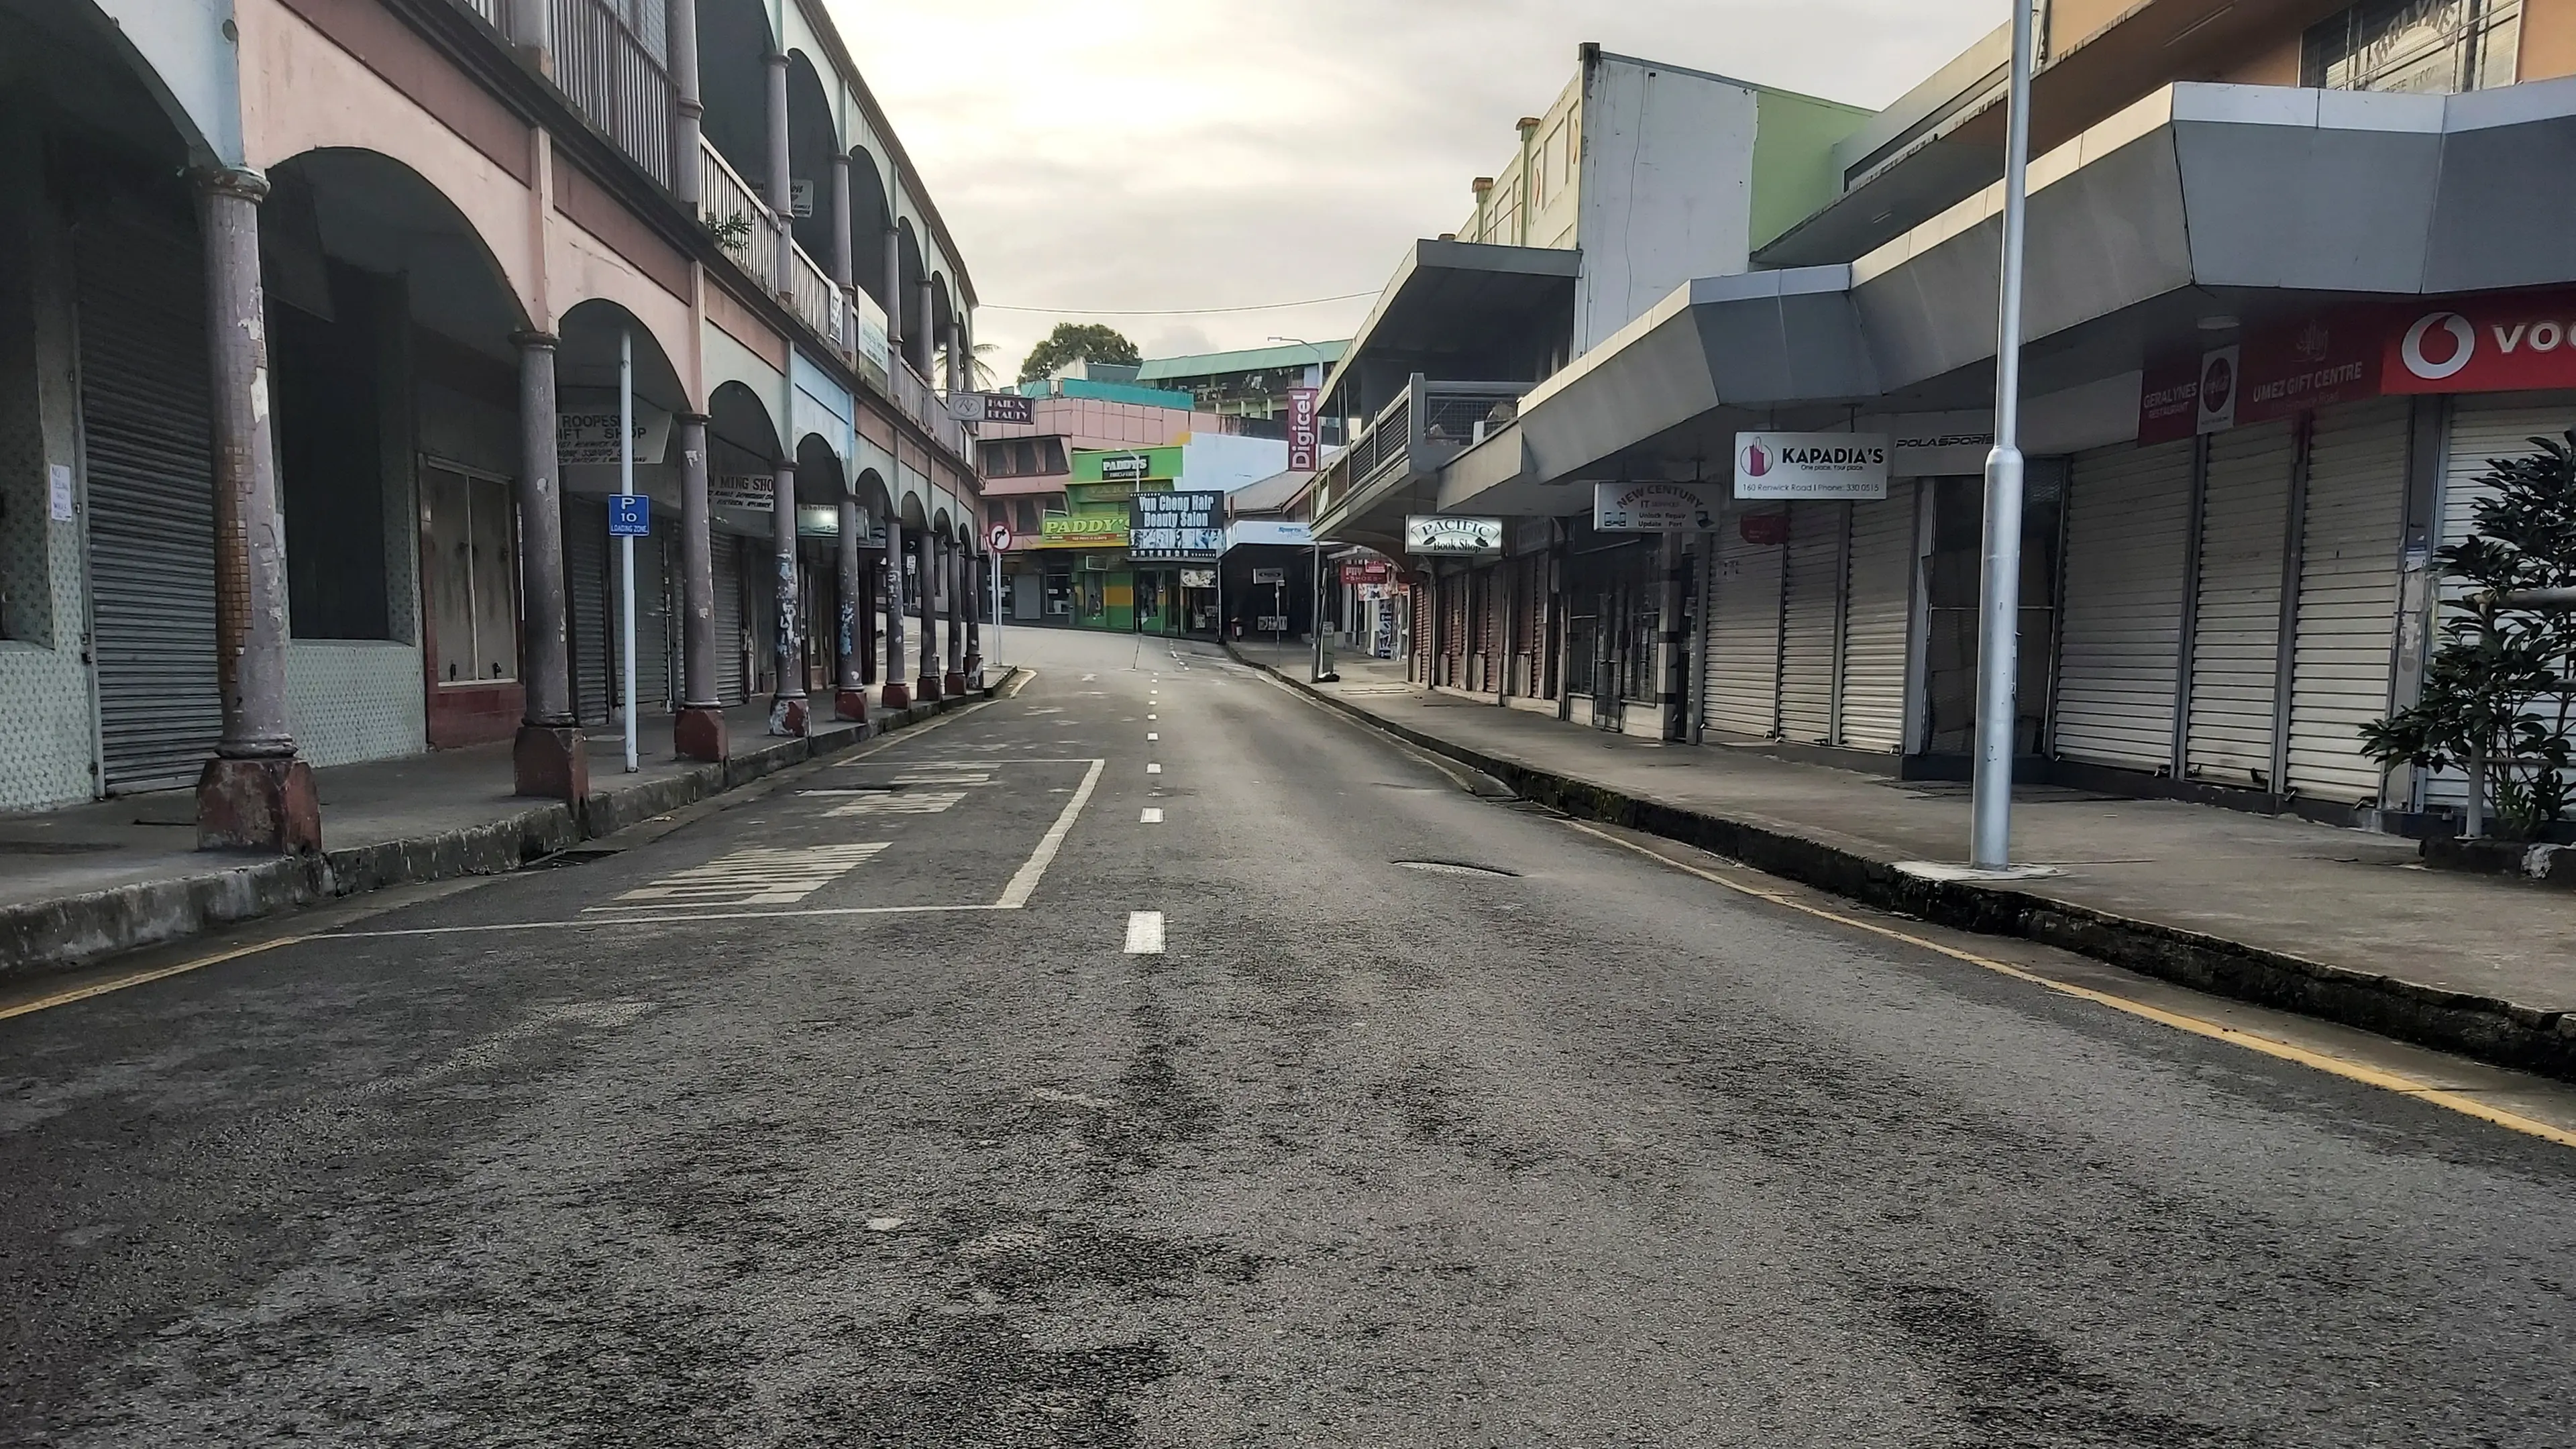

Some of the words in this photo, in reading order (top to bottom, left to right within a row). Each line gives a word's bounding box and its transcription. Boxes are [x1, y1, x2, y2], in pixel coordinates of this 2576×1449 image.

[2253, 380, 2286, 402] UMEZ
[2287, 373, 2314, 394] GIFT
[2314, 361, 2363, 388] CENTRE
[2143, 382, 2197, 409] GERALYNES
[988, 410, 1028, 419] BEAUTY
[2149, 402, 2190, 419] RESTAURANT
[557, 428, 583, 440] IFT
[1292, 392, 1315, 468] Digicel
[1782, 447, 1884, 464] KAPADIA'S
[720, 476, 749, 490] MING
[753, 478, 773, 492] SHO
[1758, 483, 1788, 491] Renwick
[1792, 483, 1811, 491] Road
[621, 497, 635, 510] P
[1192, 495, 1214, 511] Hair
[1616, 488, 1644, 508] NEW
[1648, 484, 1704, 508] CENTURY
[1641, 500, 1650, 508] IT
[621, 513, 637, 522] 10
[1144, 513, 1177, 528] Beauty
[1180, 512, 1208, 527] Salon
[611, 524, 633, 532] LOADING
[634, 525, 647, 533] ZONE
[1421, 519, 1490, 537] PACIFIC
[1433, 539, 1456, 551] Book
[1458, 539, 1481, 553] Shop
